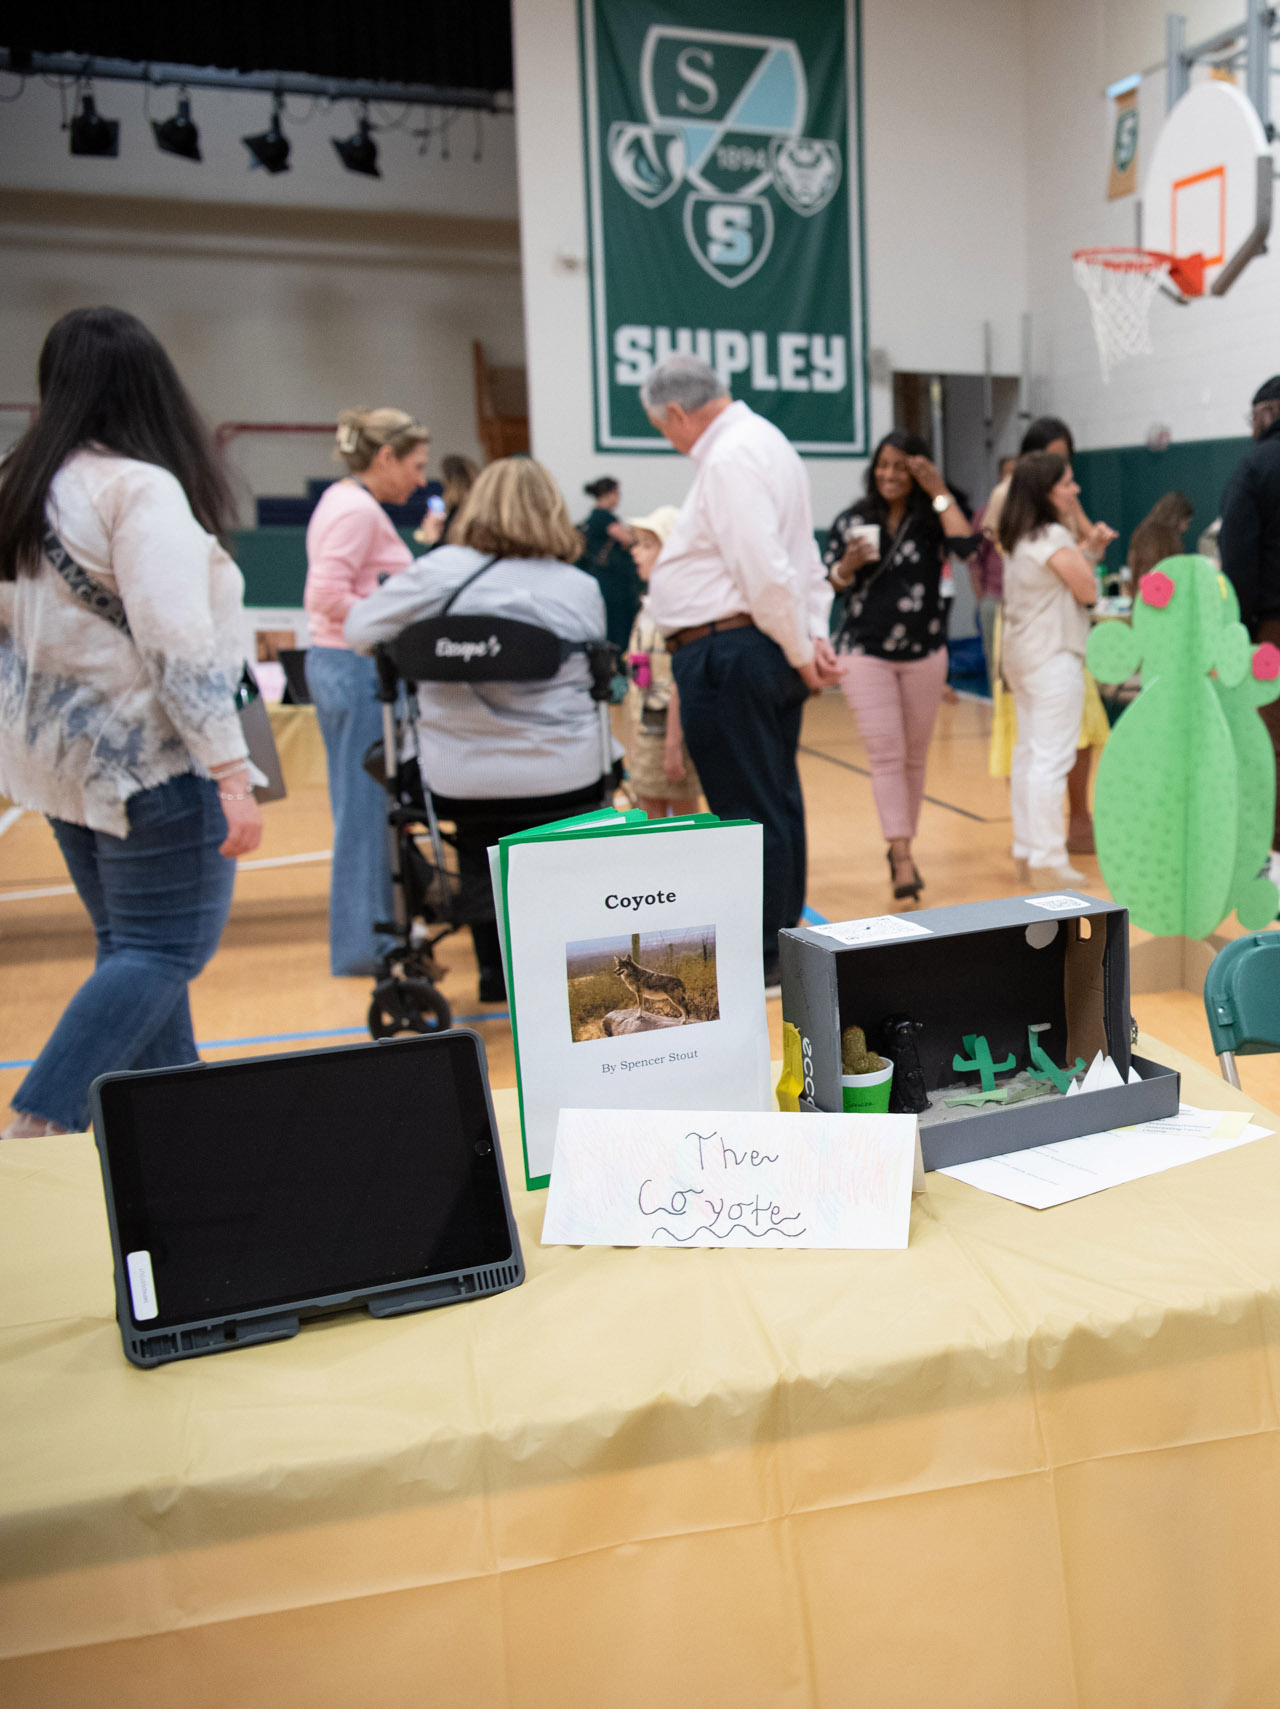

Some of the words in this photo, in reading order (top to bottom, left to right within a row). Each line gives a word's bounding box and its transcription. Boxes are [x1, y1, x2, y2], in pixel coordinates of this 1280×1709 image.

[677, 47, 718, 113] S
[706, 204, 752, 265] S
[605, 890, 677, 911] Coyote
[602, 1063, 617, 1074] By
[620, 1056, 665, 1071] Spencer
[668, 1050, 699, 1062] Stout
[638, 1179, 801, 1227] Coyote
